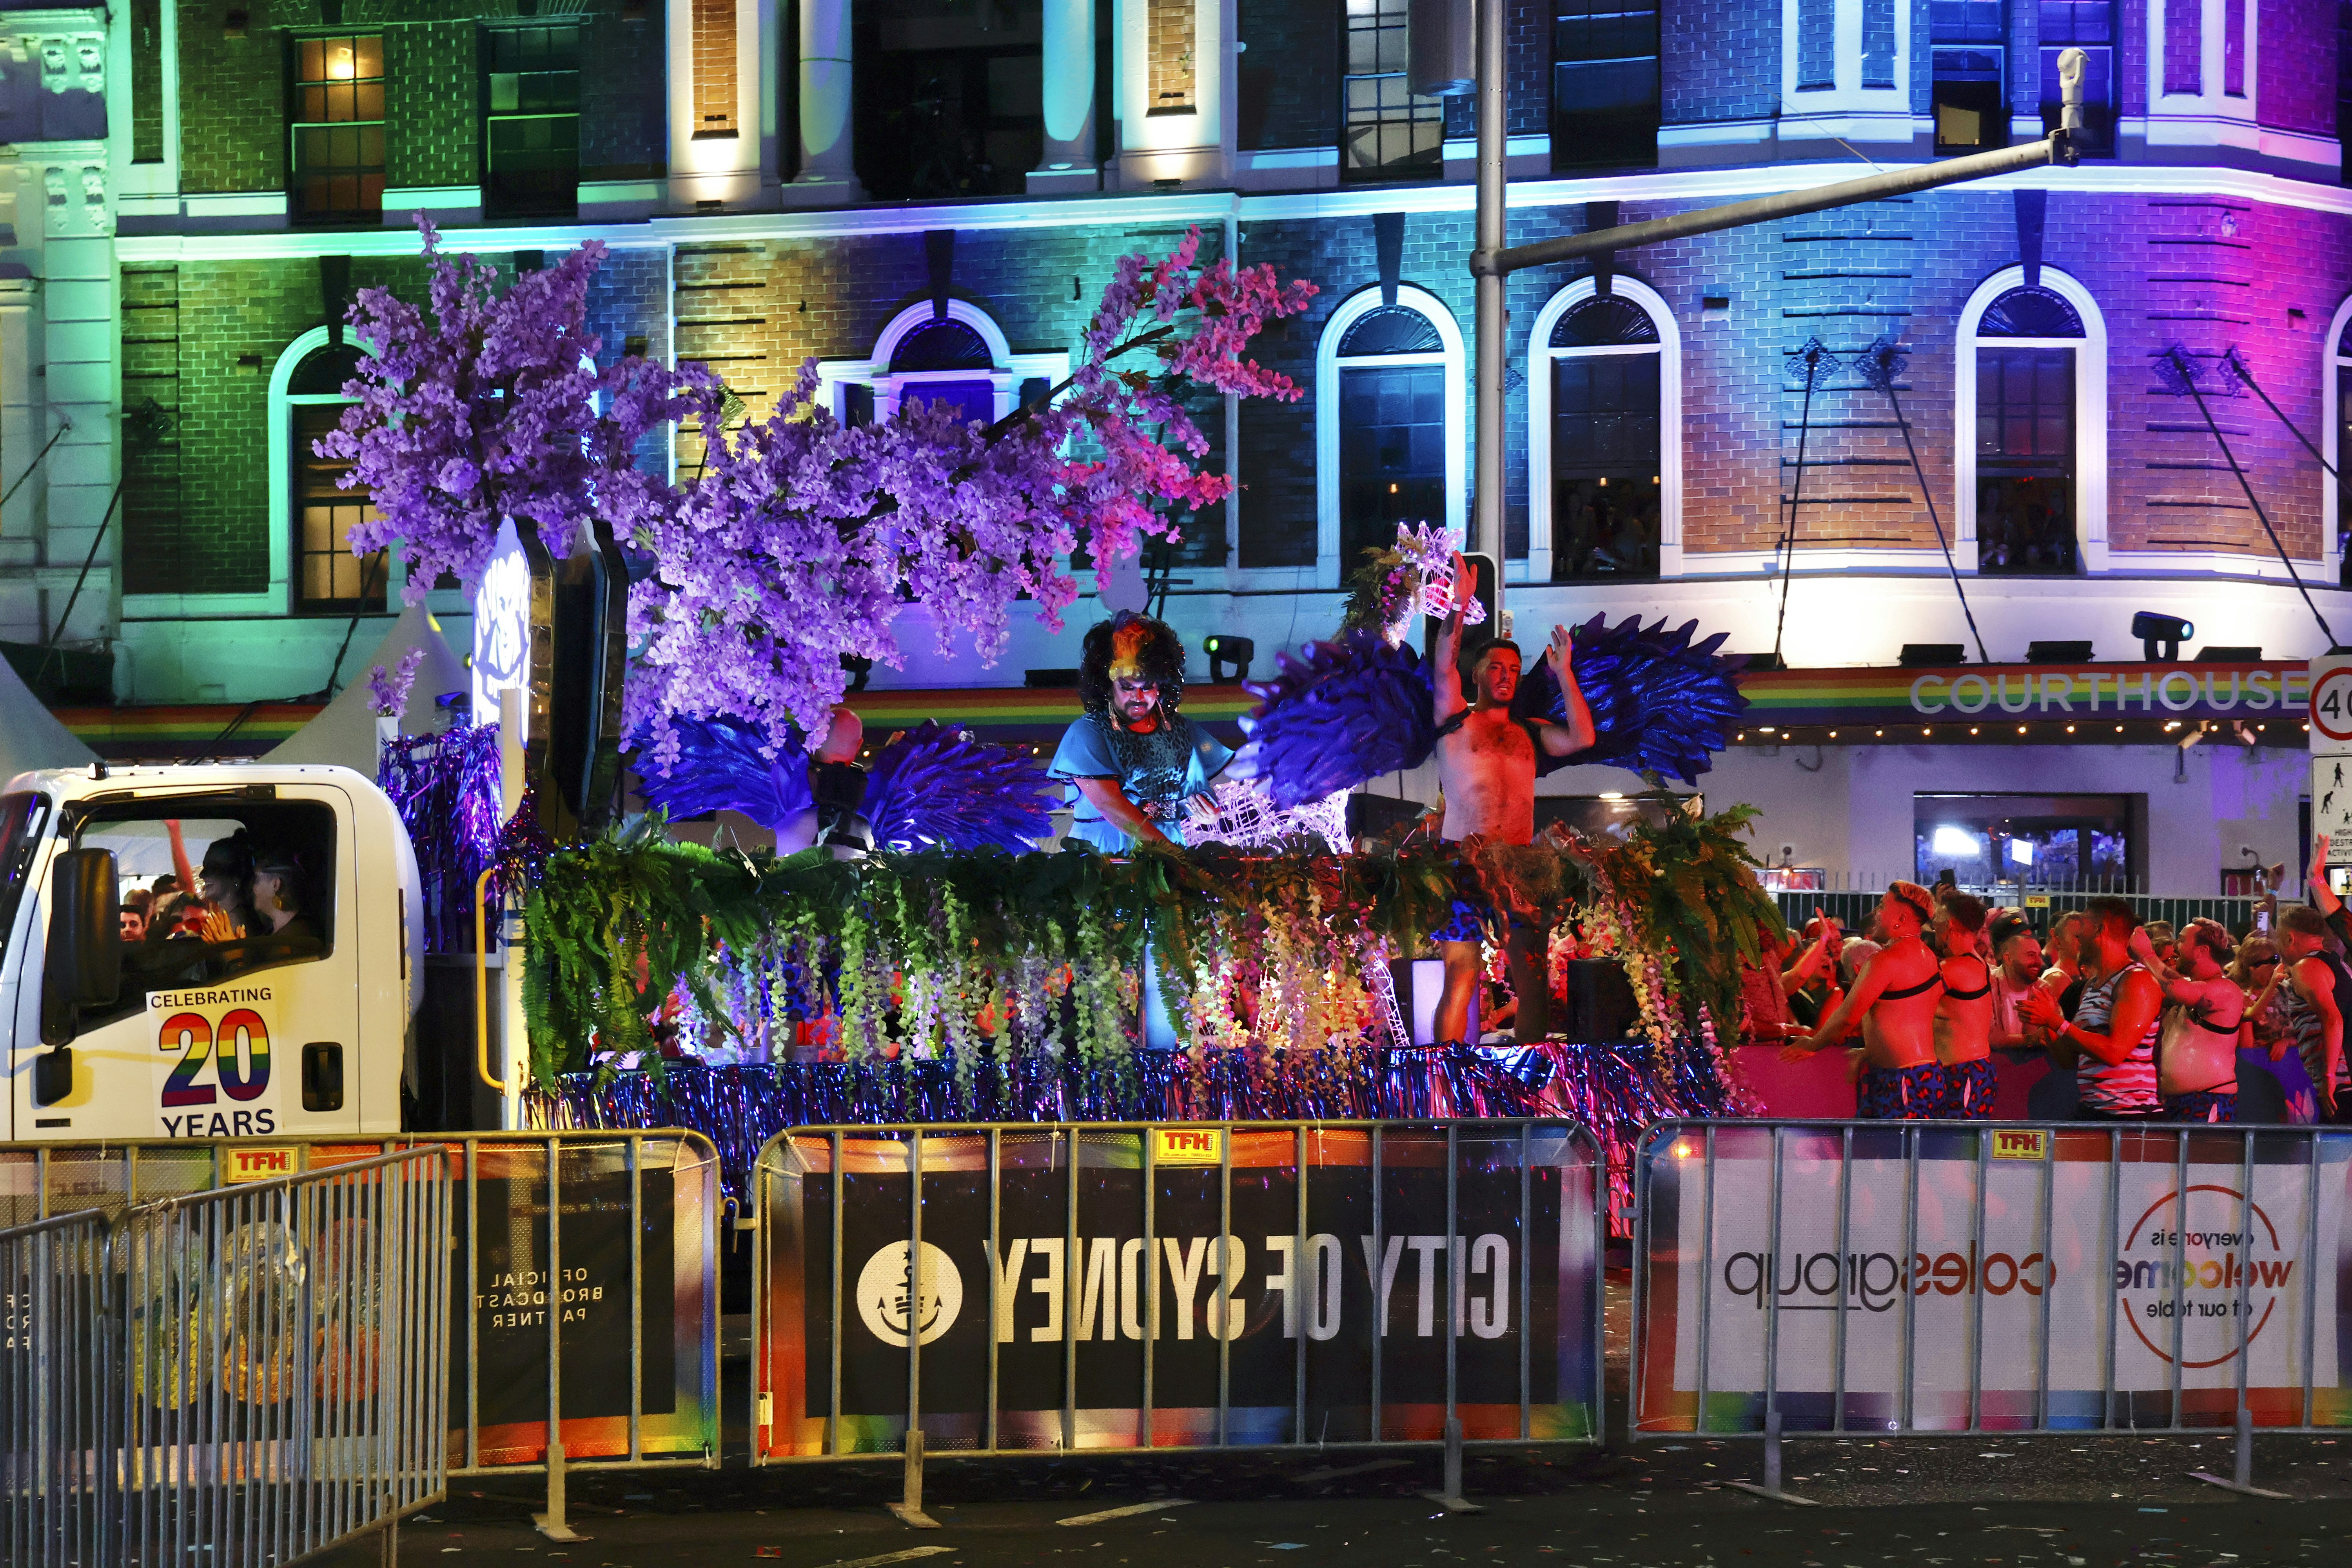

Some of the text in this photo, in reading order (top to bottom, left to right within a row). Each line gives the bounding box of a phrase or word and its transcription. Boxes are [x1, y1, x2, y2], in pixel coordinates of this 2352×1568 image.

[1909, 670, 2309, 714] COURTHOUSE
[2321, 689, 2352, 720] 4
[151, 987, 271, 1008] CELEBRATING
[159, 1008, 270, 1107] 20
[161, 1109, 275, 1137] YEARS
[1165, 1132, 1209, 1150] TFH
[1999, 1134, 2037, 1150] TFH
[236, 1151, 285, 1171] TFH
